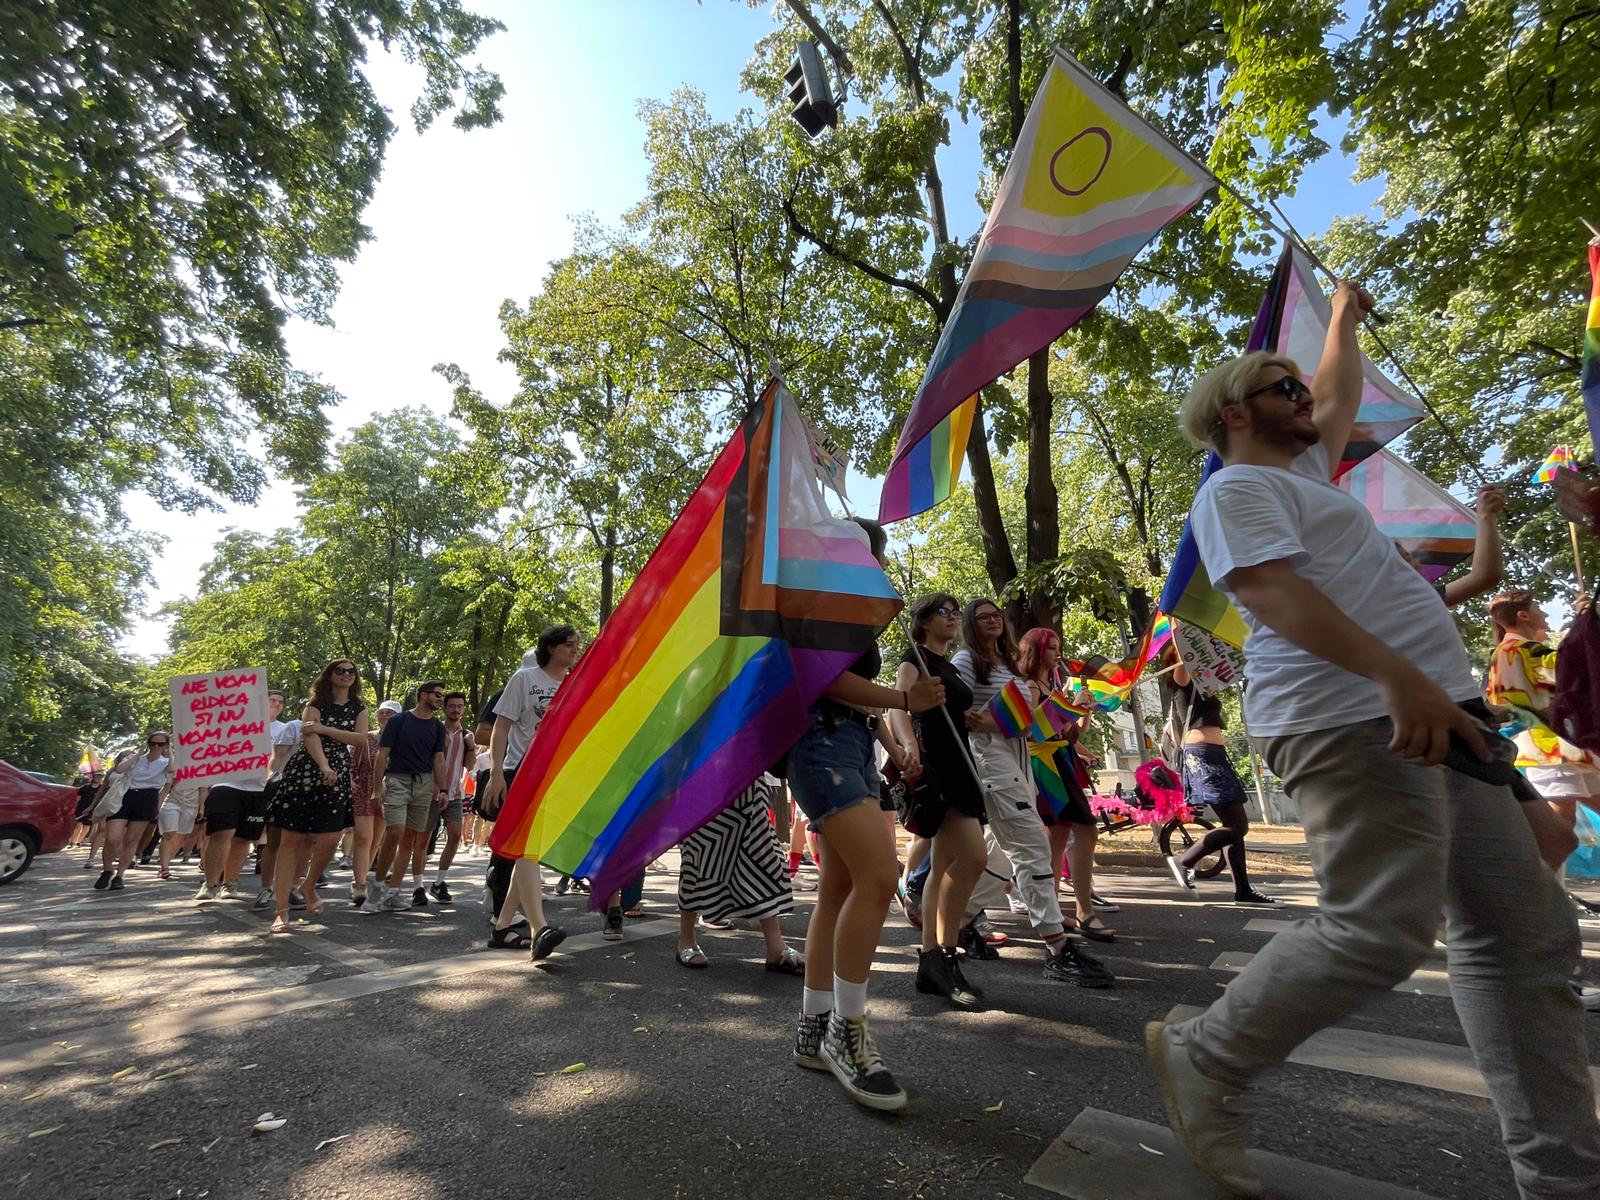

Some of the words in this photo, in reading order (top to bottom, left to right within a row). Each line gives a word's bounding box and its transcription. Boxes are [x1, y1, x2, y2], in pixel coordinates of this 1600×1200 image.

[1210, 660, 1235, 683] NU
[181, 679, 209, 695] NE
[214, 673, 257, 690] VOM
[529, 684, 545, 696] San
[190, 692, 249, 712] RIDICA
[217, 706, 246, 723] NU
[177, 727, 222, 746] VOM
[226, 719, 265, 738] MAI
